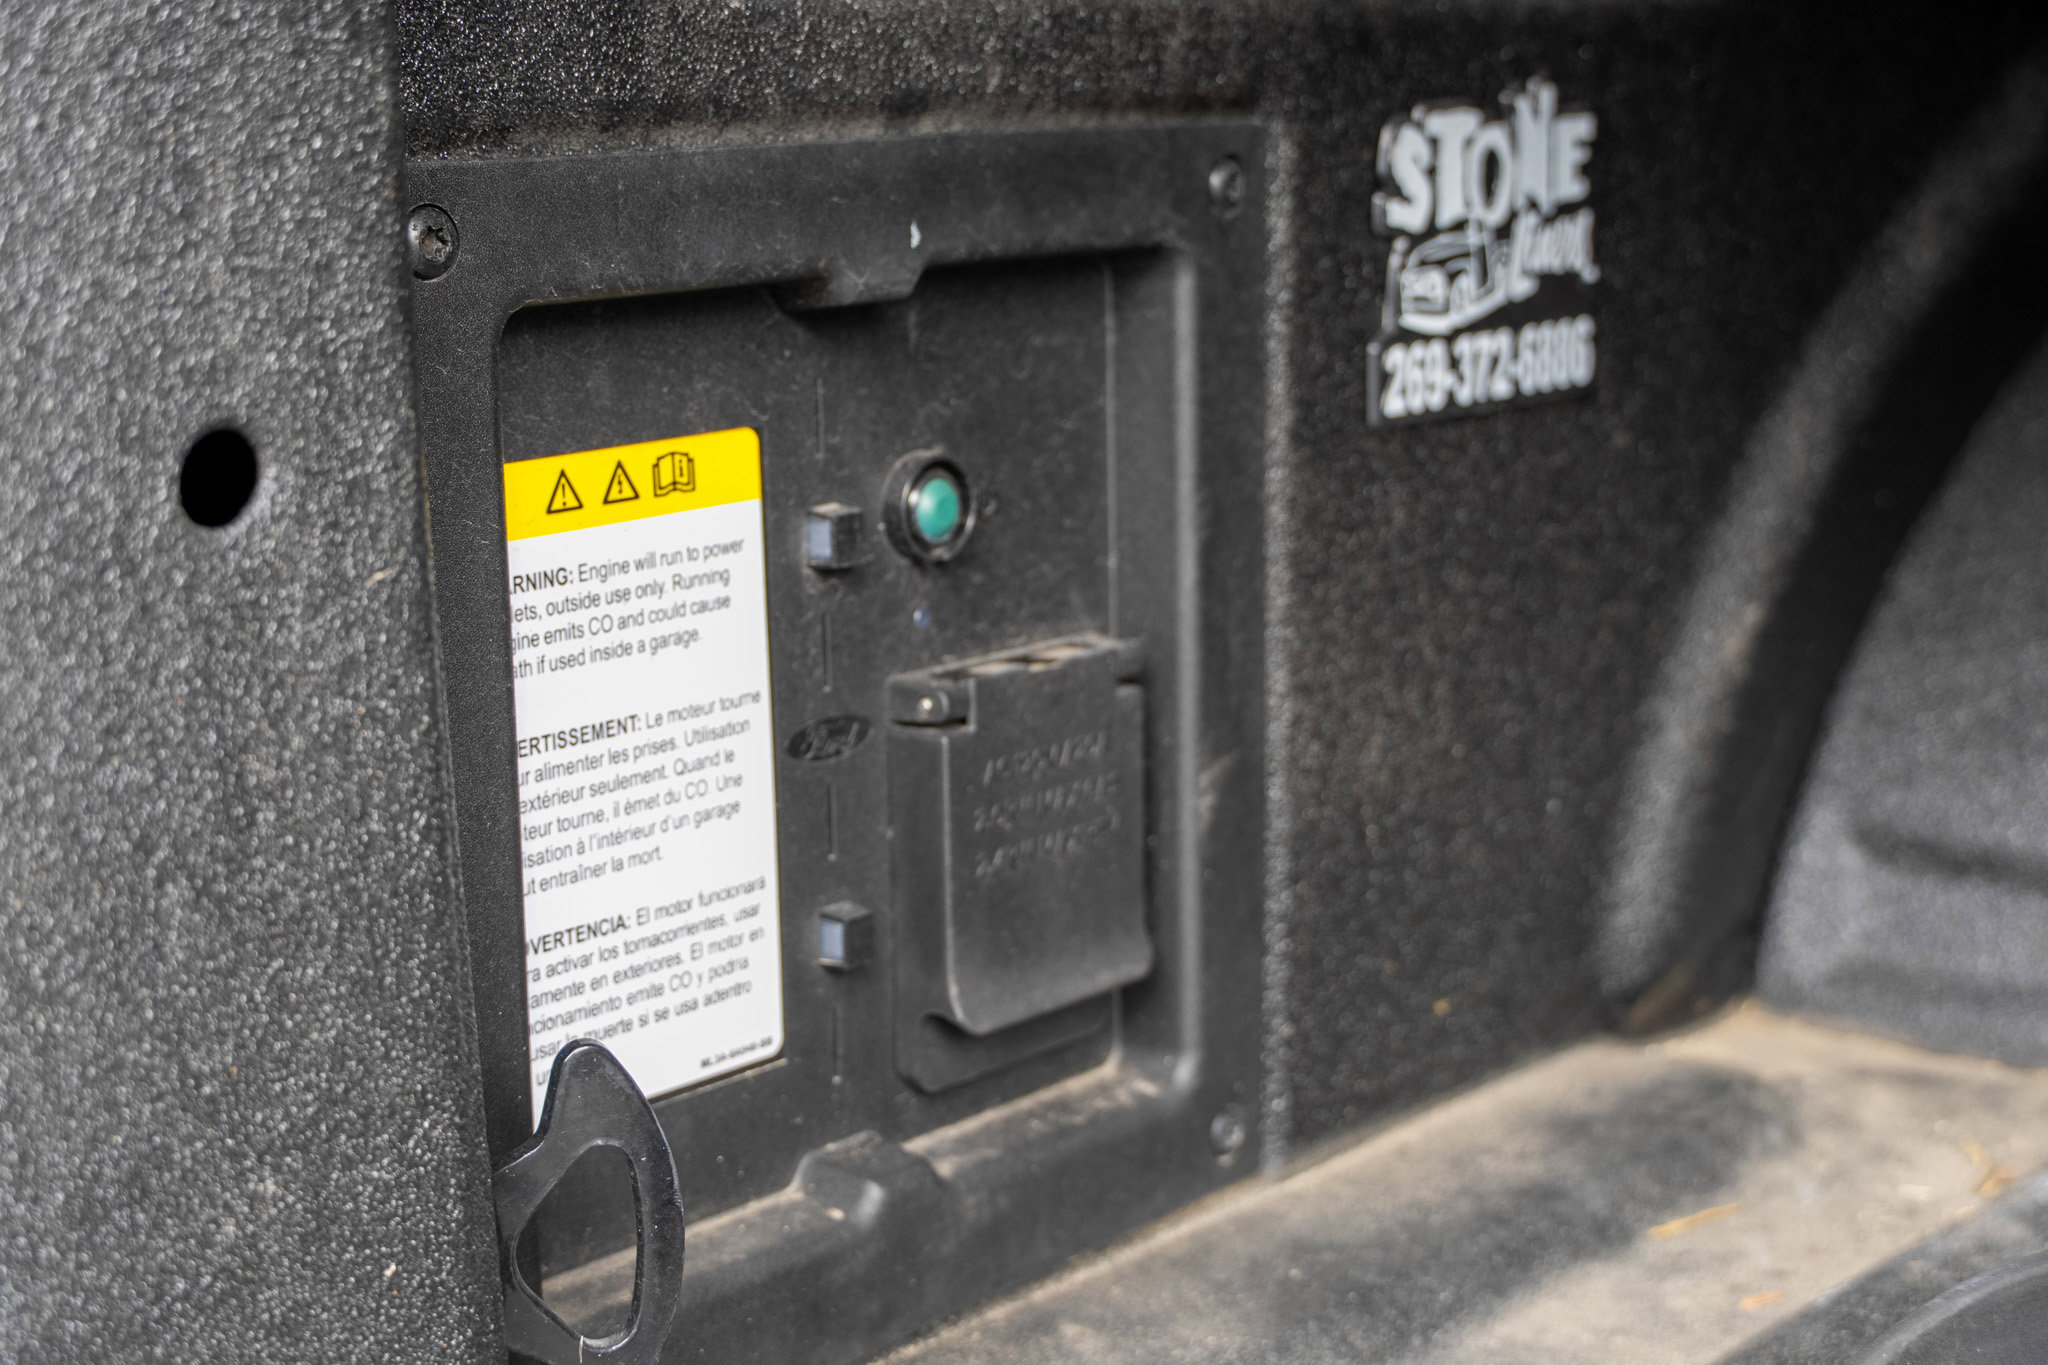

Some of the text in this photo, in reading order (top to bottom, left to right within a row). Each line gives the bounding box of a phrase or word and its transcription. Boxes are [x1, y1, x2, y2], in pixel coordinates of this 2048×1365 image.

[1379, 76, 1598, 234] STONE
[510, 538, 744, 595] RNING: Engine will run to power
[546, 590, 601, 618] outside
[605, 587, 631, 604] use
[635, 577, 668, 600] only.
[672, 567, 730, 591] Running
[544, 622, 584, 645] emits
[588, 615, 613, 636] CO
[617, 609, 644, 631] and
[648, 601, 686, 623] could
[690, 595, 731, 616] cause
[537, 656, 546, 673] if
[550, 649, 585, 672] used
[590, 640, 632, 663] inside
[637, 639, 645, 653] a
[650, 627, 703, 655] garage.
[518, 688, 761, 758] ERTISSEMENT: Le moteur tourne
[535, 754, 603, 779] alimenter
[608, 747, 630, 765] les
[633, 736, 678, 760] prises.
[684, 717, 751, 747] Utilisation
[589, 765, 668, 797] seulement.
[673, 751, 720, 777] Quand
[724, 747, 735, 763] le
[557, 807, 610, 833] tourne,
[613, 801, 621, 819] il
[624, 793, 661, 817] émet
[664, 788, 681, 805] du
[716, 773, 743, 792] Une
[577, 837, 585, 855] à
[660, 812, 690, 832] d'un
[694, 799, 741, 827] garage
[539, 860, 607, 893] entraîner
[611, 856, 624, 872] la
[526, 876, 766, 956] VERTENCIA: El motor funcionará
[546, 948, 593, 978] activar
[599, 942, 618, 962] los
[734, 901, 761, 922] usar
[591, 974, 609, 991] en
[613, 952, 684, 984] exteriores.
[690, 940, 704, 961] El
[707, 931, 744, 955] motor
[749, 925, 765, 941] en
[583, 1018, 633, 1040] muerte
[638, 1008, 649, 1028] si
[654, 1005, 670, 1022] se
[675, 995, 698, 1016] usa
[703, 979, 753, 1008] adentro
[626, 981, 664, 1006] emite
[669, 970, 692, 992] CO
[696, 975, 703, 988] y
